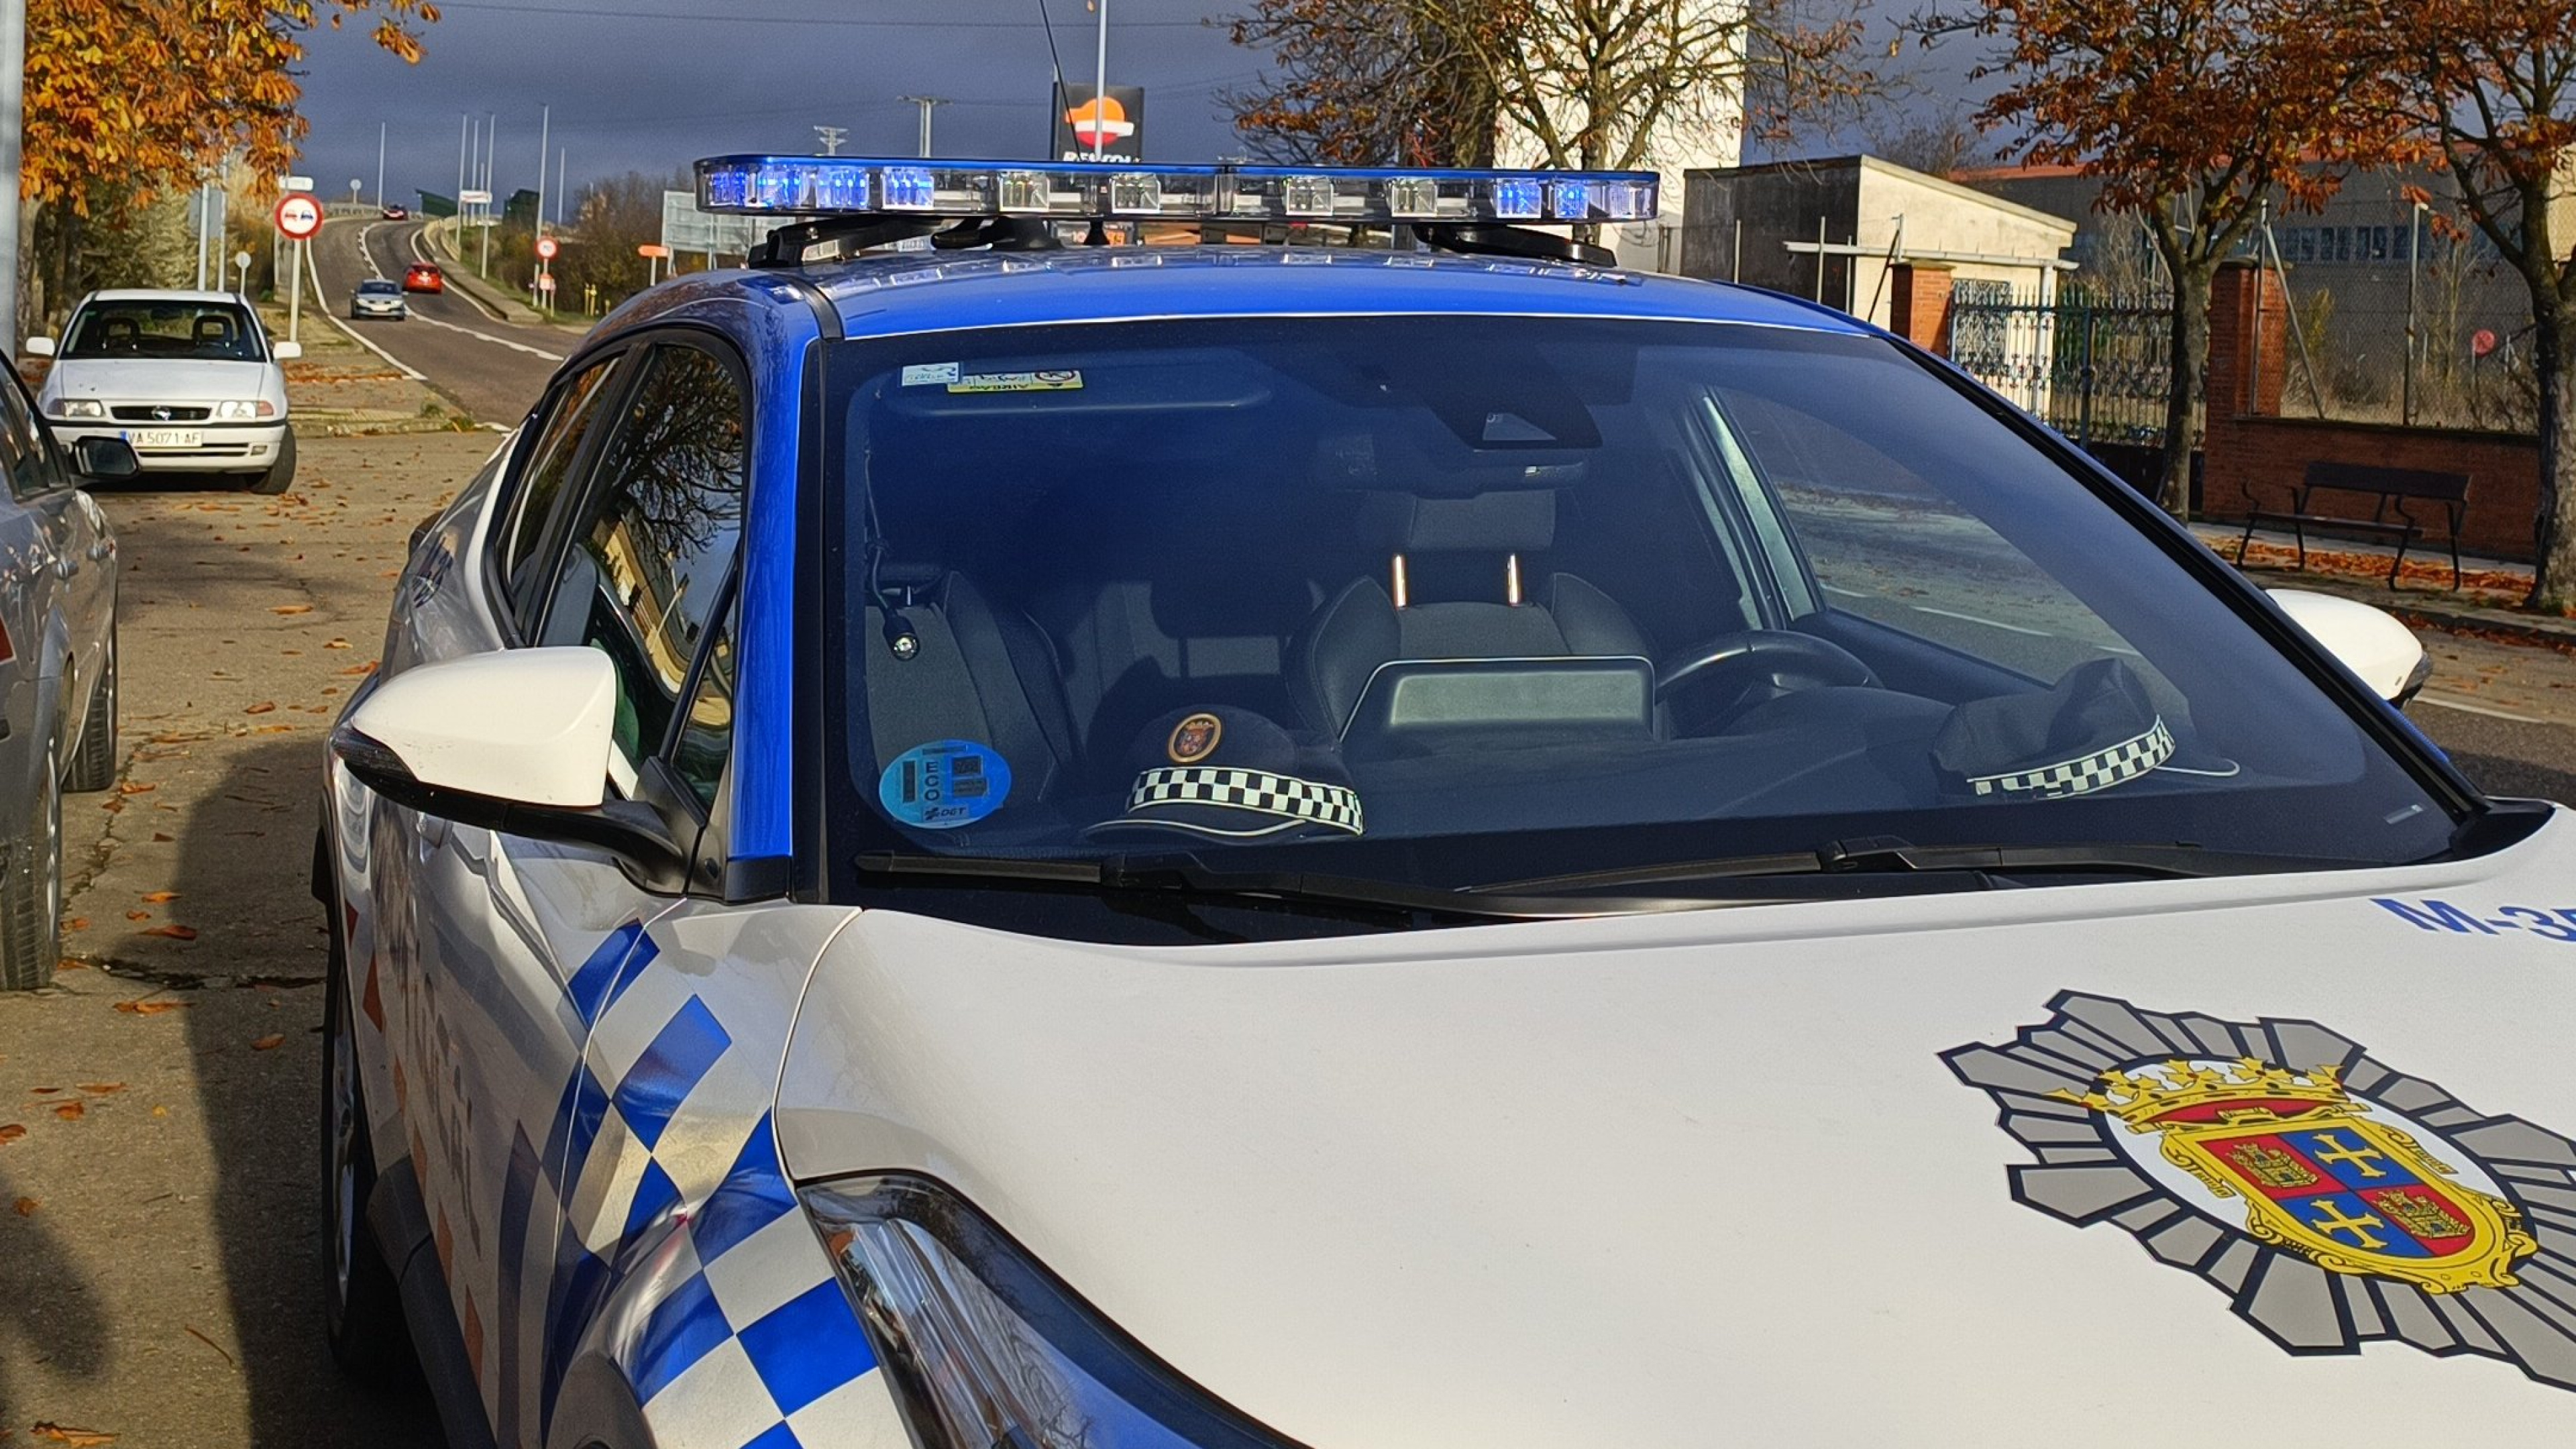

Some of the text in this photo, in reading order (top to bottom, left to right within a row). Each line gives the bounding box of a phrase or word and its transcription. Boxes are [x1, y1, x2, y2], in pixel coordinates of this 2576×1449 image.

[128, 431, 143, 444] VA
[924, 761, 941, 802] ECO
[941, 807, 967, 816] DGT
